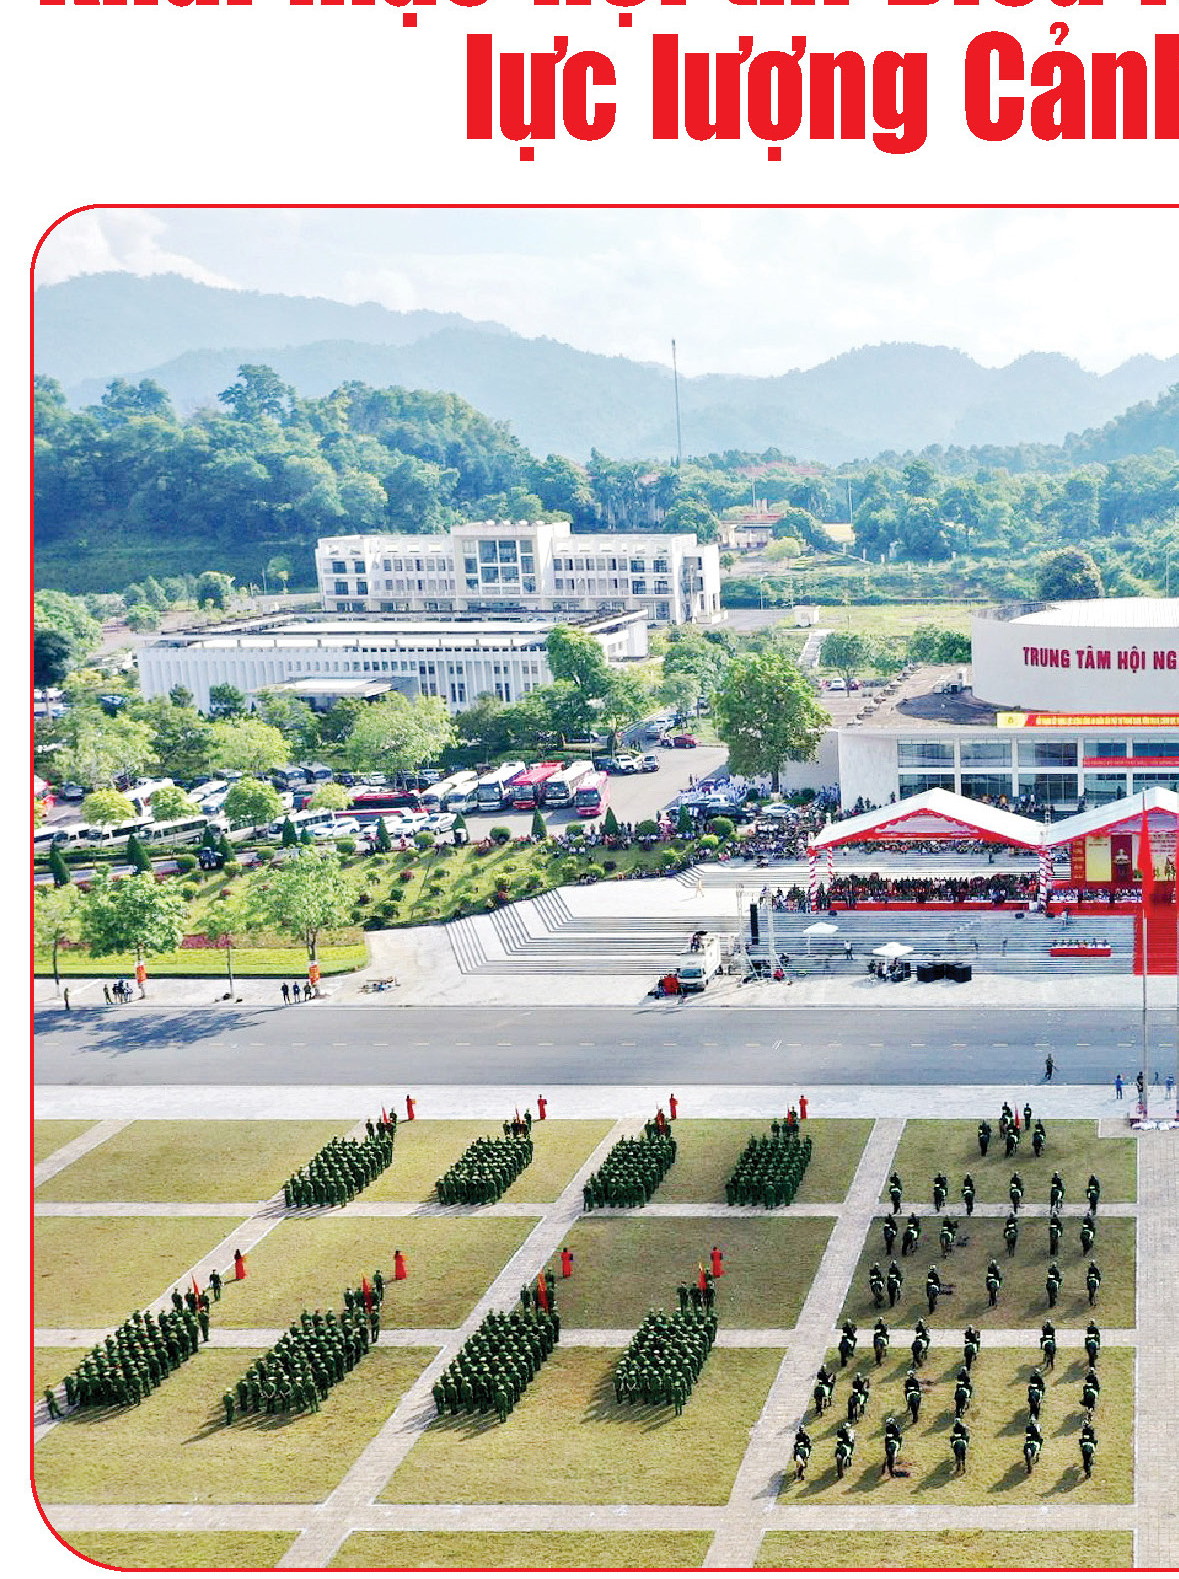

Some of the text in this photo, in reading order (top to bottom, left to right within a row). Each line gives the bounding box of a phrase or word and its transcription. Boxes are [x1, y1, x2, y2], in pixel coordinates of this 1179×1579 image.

[1023, 646, 1071, 668] TRUNG
[1075, 645, 1111, 669] TÂM
[1117, 645, 1146, 673] HỘI
